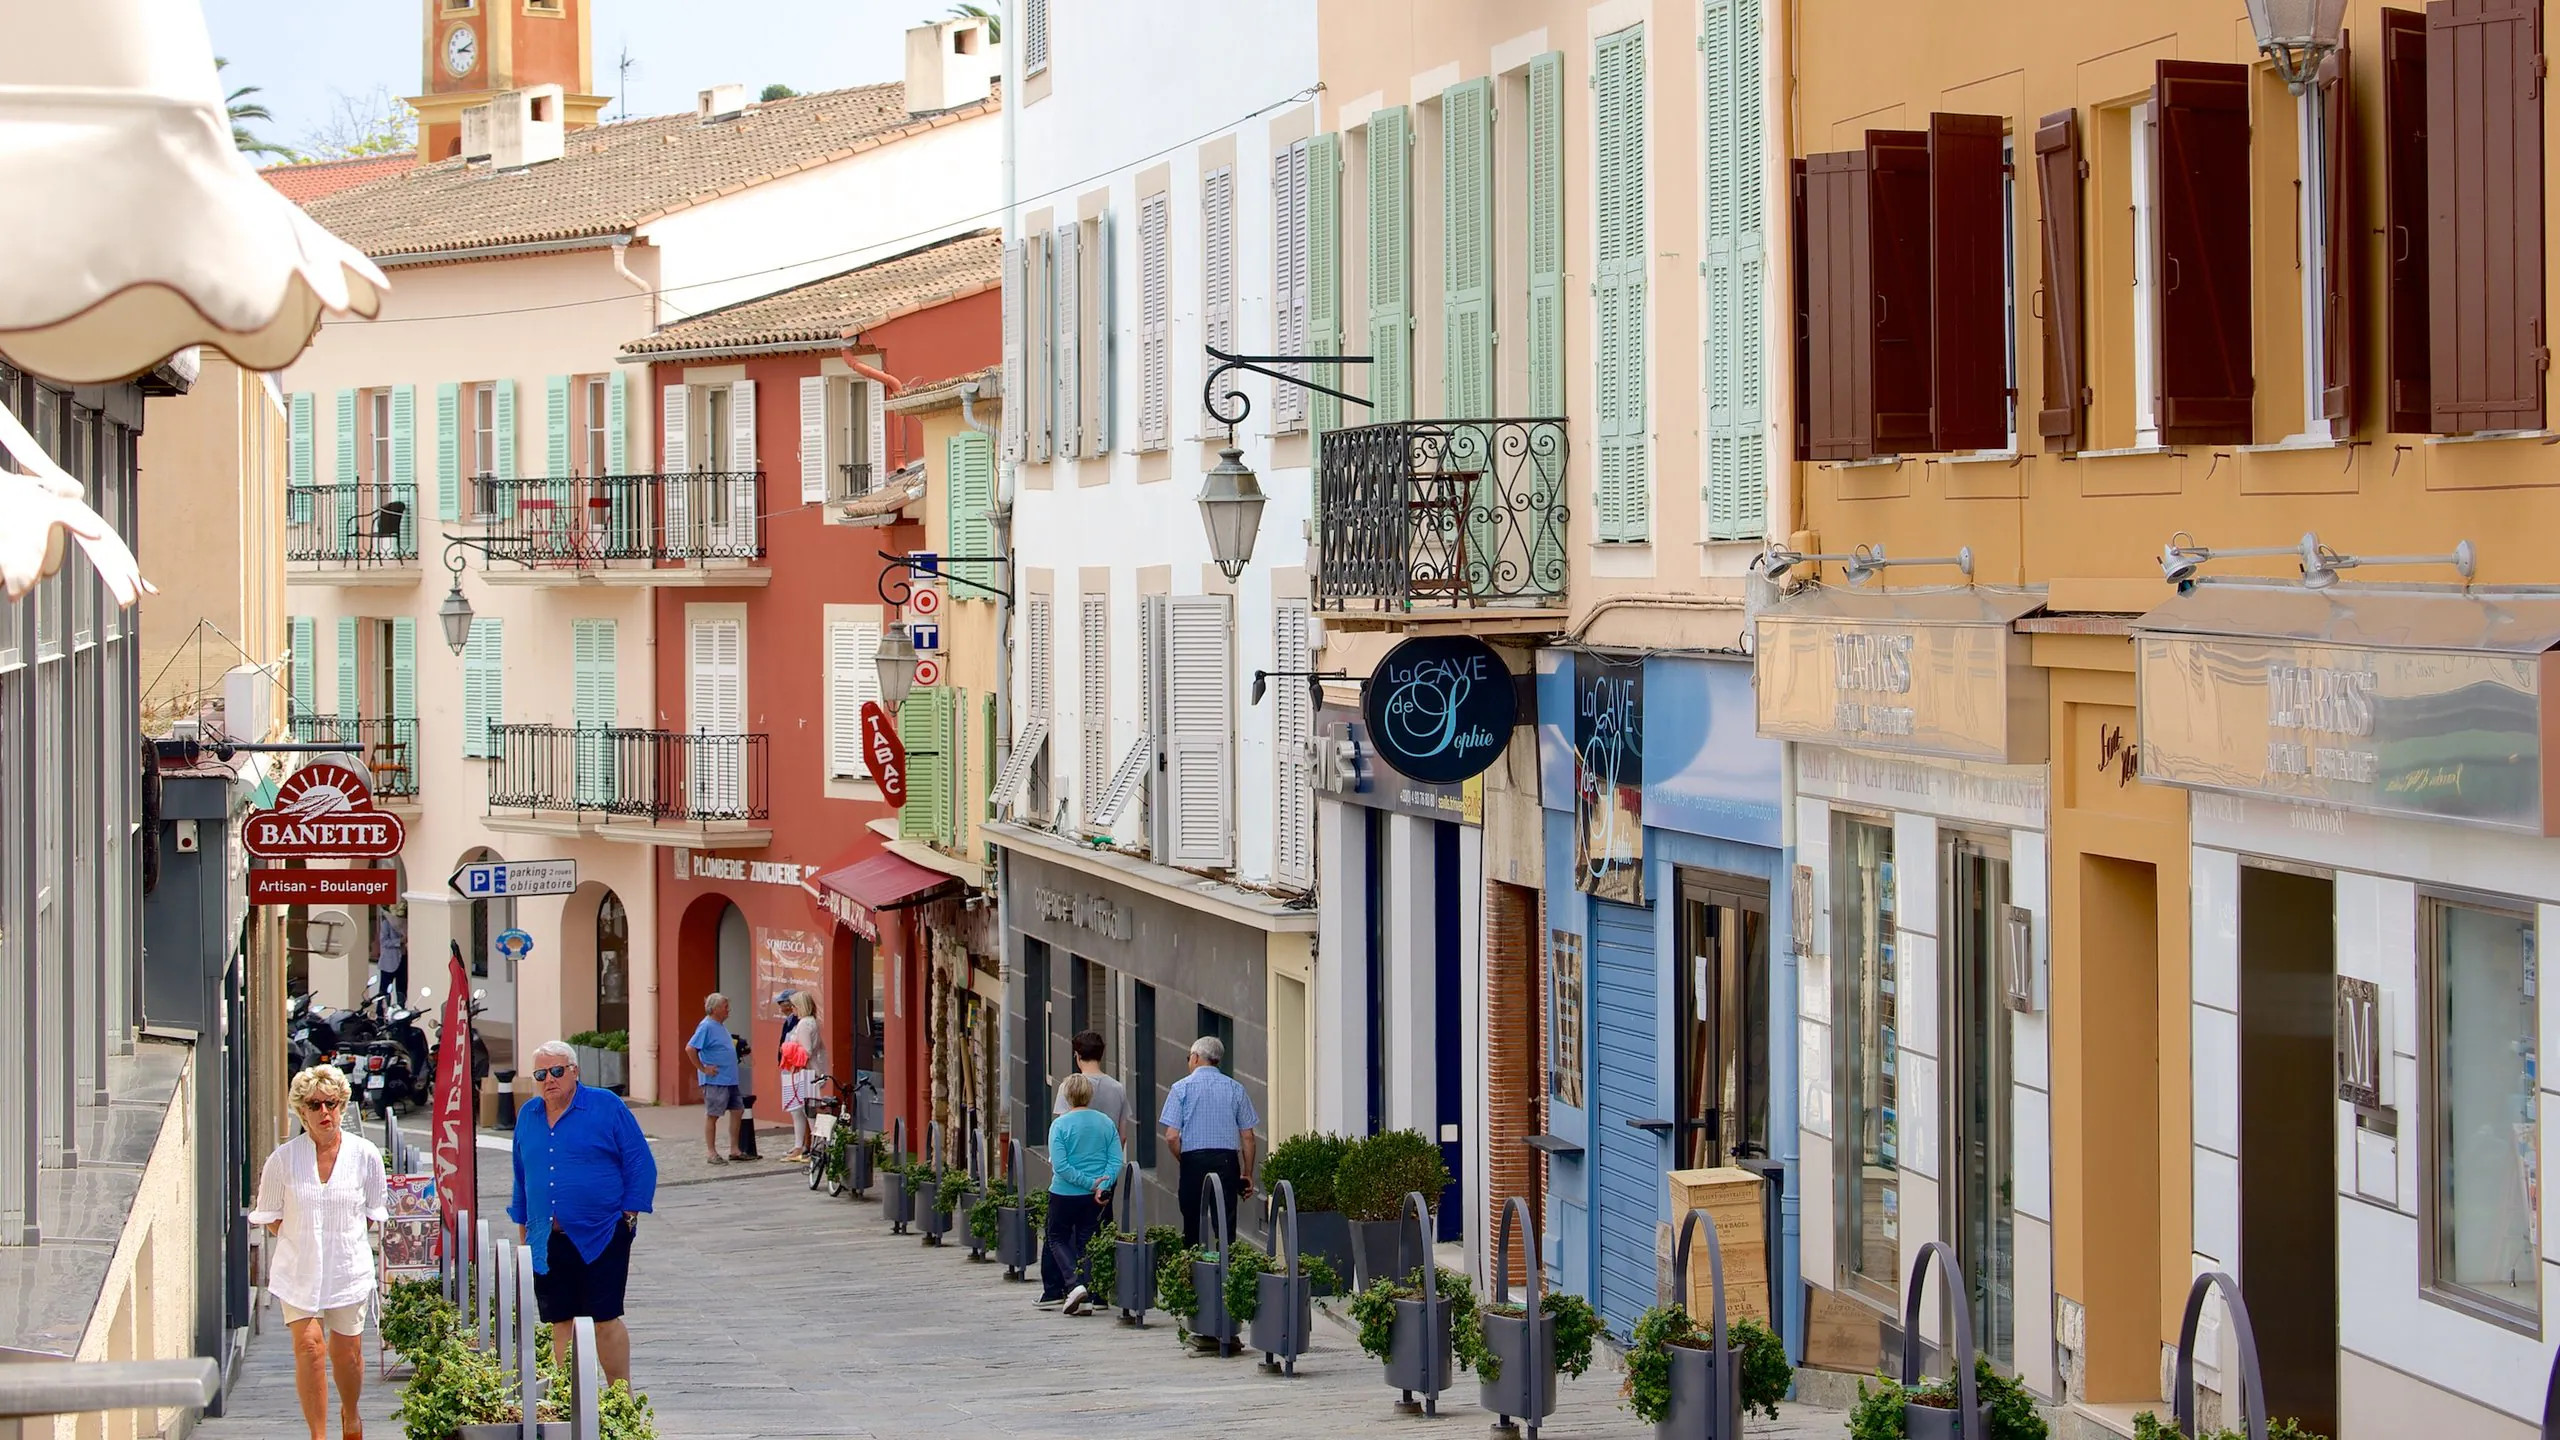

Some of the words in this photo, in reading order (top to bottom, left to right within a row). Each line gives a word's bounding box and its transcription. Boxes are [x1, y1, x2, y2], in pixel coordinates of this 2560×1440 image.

[1392, 695, 1414, 714] de
[867, 715, 901, 795] TABAC
[1584, 760, 1594, 793] de
[1864, 758, 1885, 789] CAP
[1889, 762, 1930, 796] FERRAT
[259, 824, 388, 845] BANETTE
[510, 867, 546, 880] parking
[694, 856, 747, 881] PLOMBERIE
[259, 880, 307, 893] Artisan
[321, 880, 389, 895] Boulanger
[511, 880, 573, 893] obligatoire
[2346, 997, 2372, 1089] M
